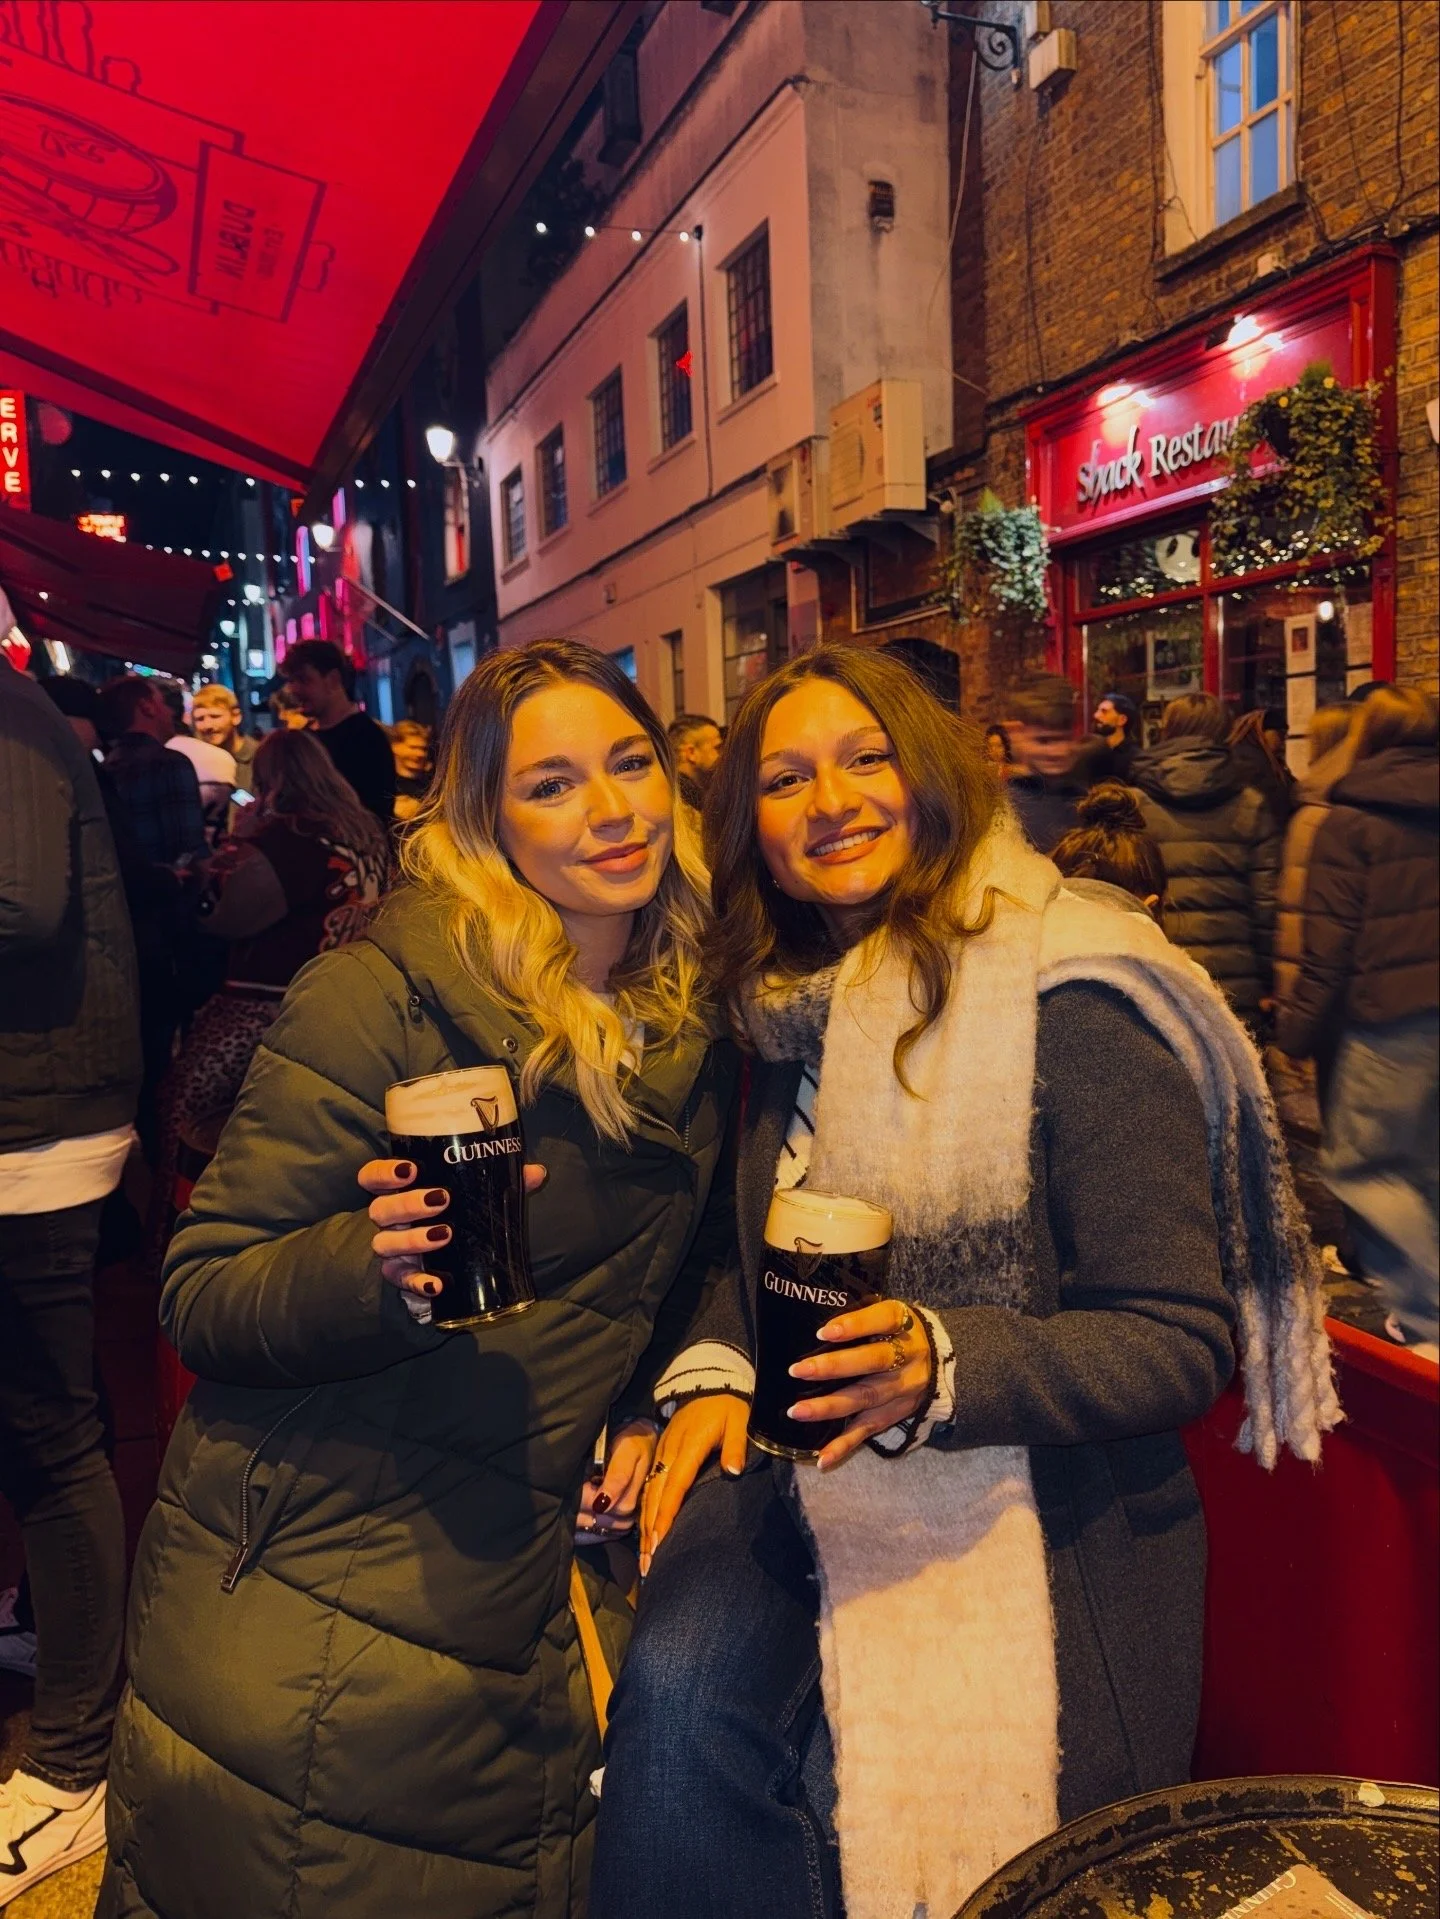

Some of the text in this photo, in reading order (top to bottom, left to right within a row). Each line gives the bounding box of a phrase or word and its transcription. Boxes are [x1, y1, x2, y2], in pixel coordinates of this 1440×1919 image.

[0, 397, 21, 493] ERVE
[443, 1137, 521, 1165] GUINNESS
[764, 1270, 848, 1307] GUINNESS
